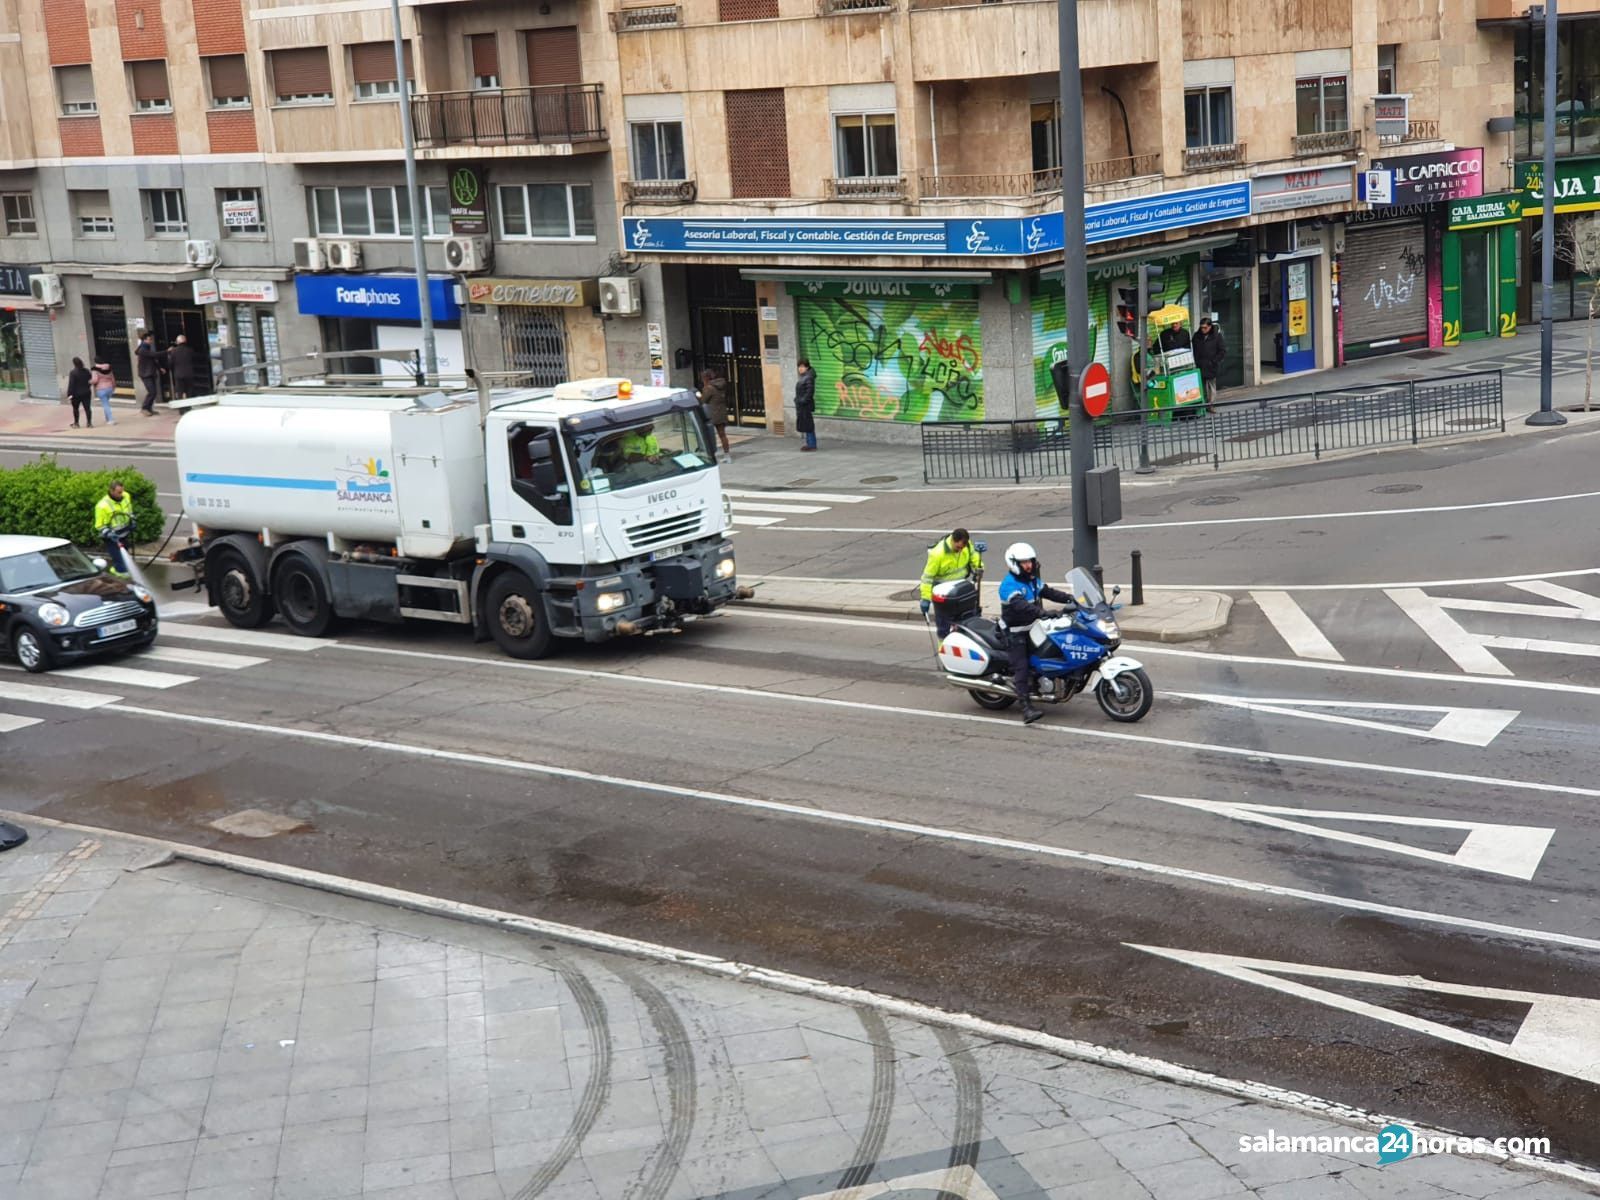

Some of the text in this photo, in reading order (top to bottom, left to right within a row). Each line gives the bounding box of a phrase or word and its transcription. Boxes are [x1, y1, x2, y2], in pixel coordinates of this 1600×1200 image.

[1408, 159, 1480, 181] CAPRICCIO
[1101, 214, 1129, 226] Laboral,
[1130, 210, 1148, 222] Fiscal
[1149, 211, 1154, 221] y
[1185, 200, 1208, 213] Gestión
[1208, 200, 1216, 209] de
[1217, 196, 1245, 208] Empresas
[1452, 202, 1506, 216] CAJA RURAL
[1467, 211, 1505, 221] SALAMANCA
[684, 230, 945, 243] Asesoría Laboral, Fiscal y Contable. Gestión de Empresas
[336, 286, 401, 307] Forallphones
[336, 490, 393, 503] SALAMANCA
[647, 489, 677, 504] IVECO
[1070, 651, 1088, 660] 112
